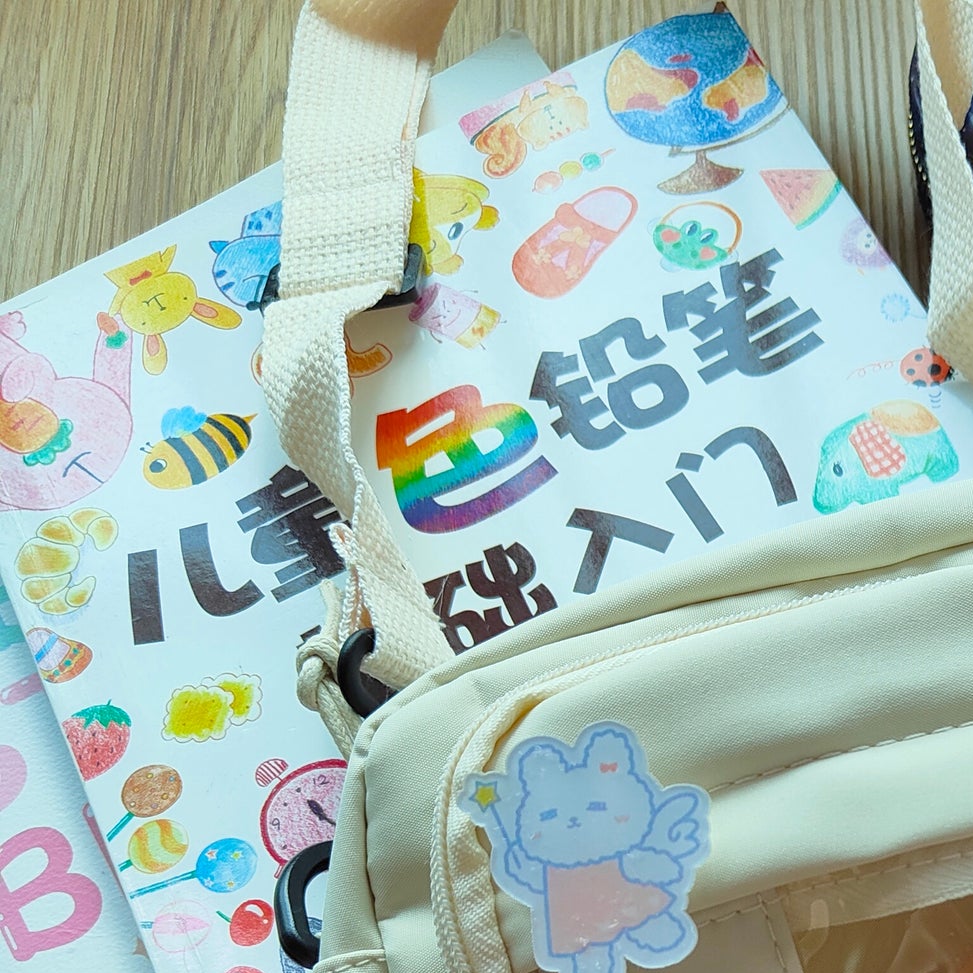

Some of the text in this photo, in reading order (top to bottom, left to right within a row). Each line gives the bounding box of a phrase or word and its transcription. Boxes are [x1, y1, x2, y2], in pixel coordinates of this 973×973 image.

[296, 426, 797, 656] 础入门
[313, 774, 330, 786] 12
[0, 803, 125, 961] B
